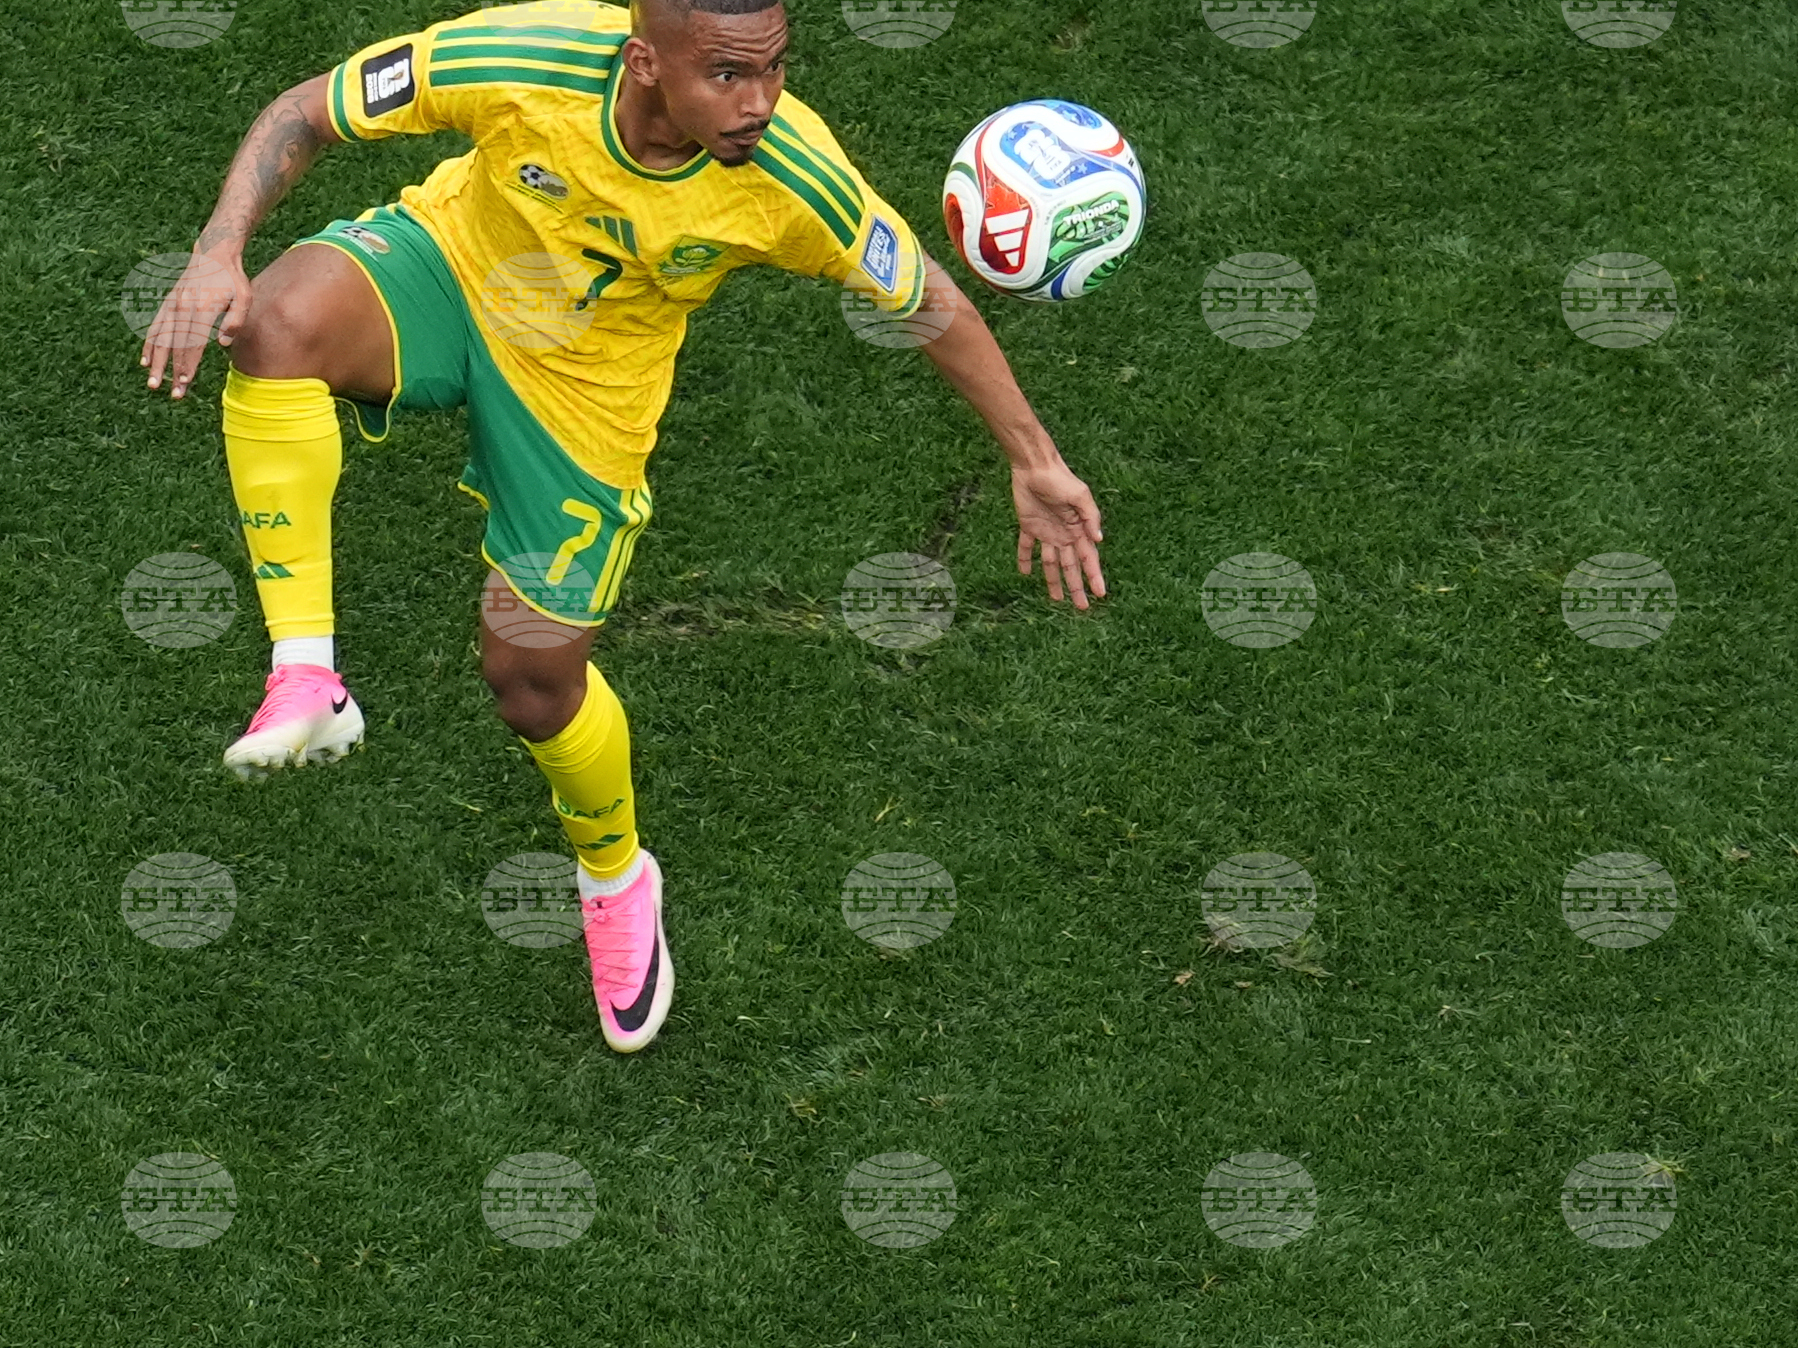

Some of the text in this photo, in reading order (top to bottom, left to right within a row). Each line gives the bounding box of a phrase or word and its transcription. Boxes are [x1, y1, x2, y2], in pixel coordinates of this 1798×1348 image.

[1063, 199, 1120, 226] TRIONDA
[575, 248, 624, 312] 7
[241, 510, 292, 529] AFA
[545, 498, 602, 586] 7
